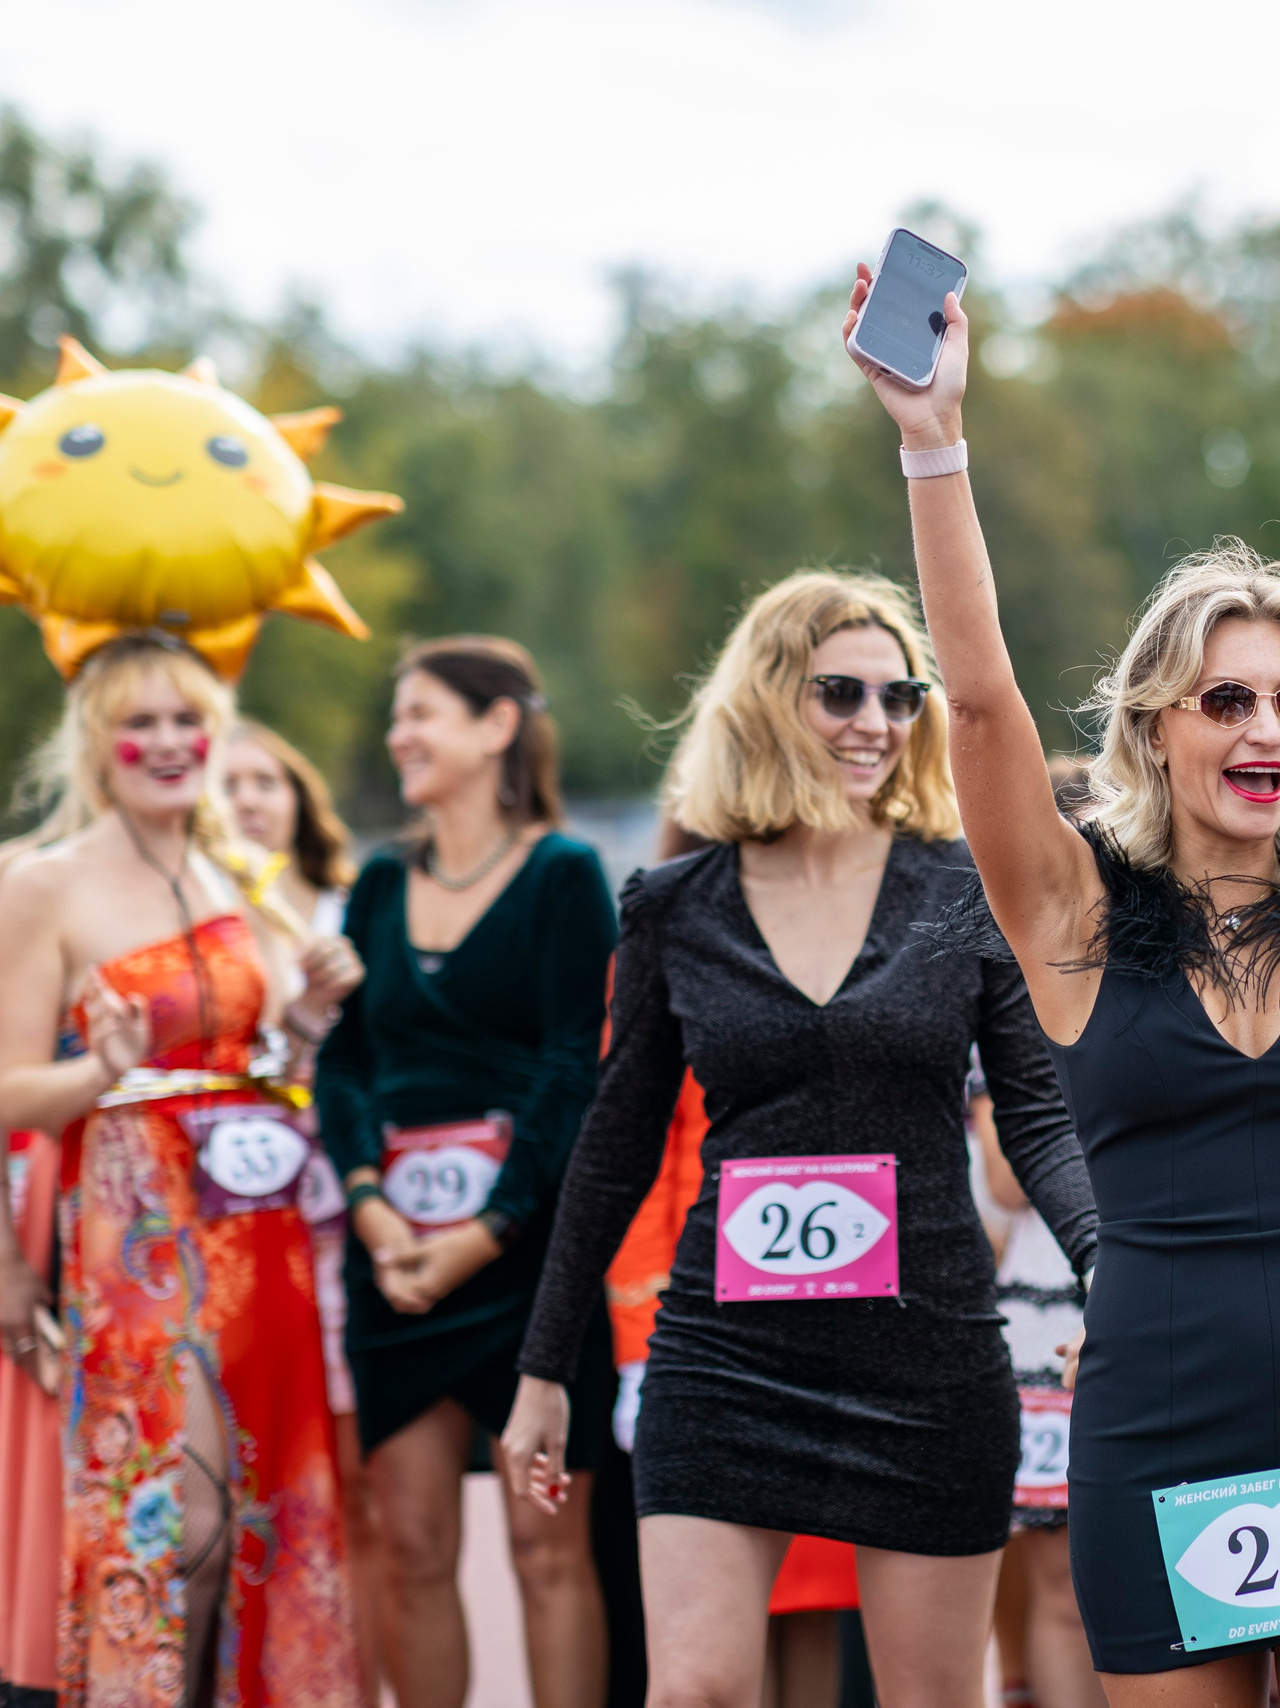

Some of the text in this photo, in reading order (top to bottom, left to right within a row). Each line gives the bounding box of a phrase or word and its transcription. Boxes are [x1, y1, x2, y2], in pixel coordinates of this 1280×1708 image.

[907, 253, 946, 280] 11:37
[406, 1162, 467, 1213] 29
[760, 1201, 865, 1261] 26 2
[1021, 1428, 1062, 1473] 2
[1174, 1483, 1237, 1507] ЖЕНСКИЙ
[1240, 1479, 1276, 1495] ЗАБЕГ
[1228, 1625, 1246, 1639] DD
